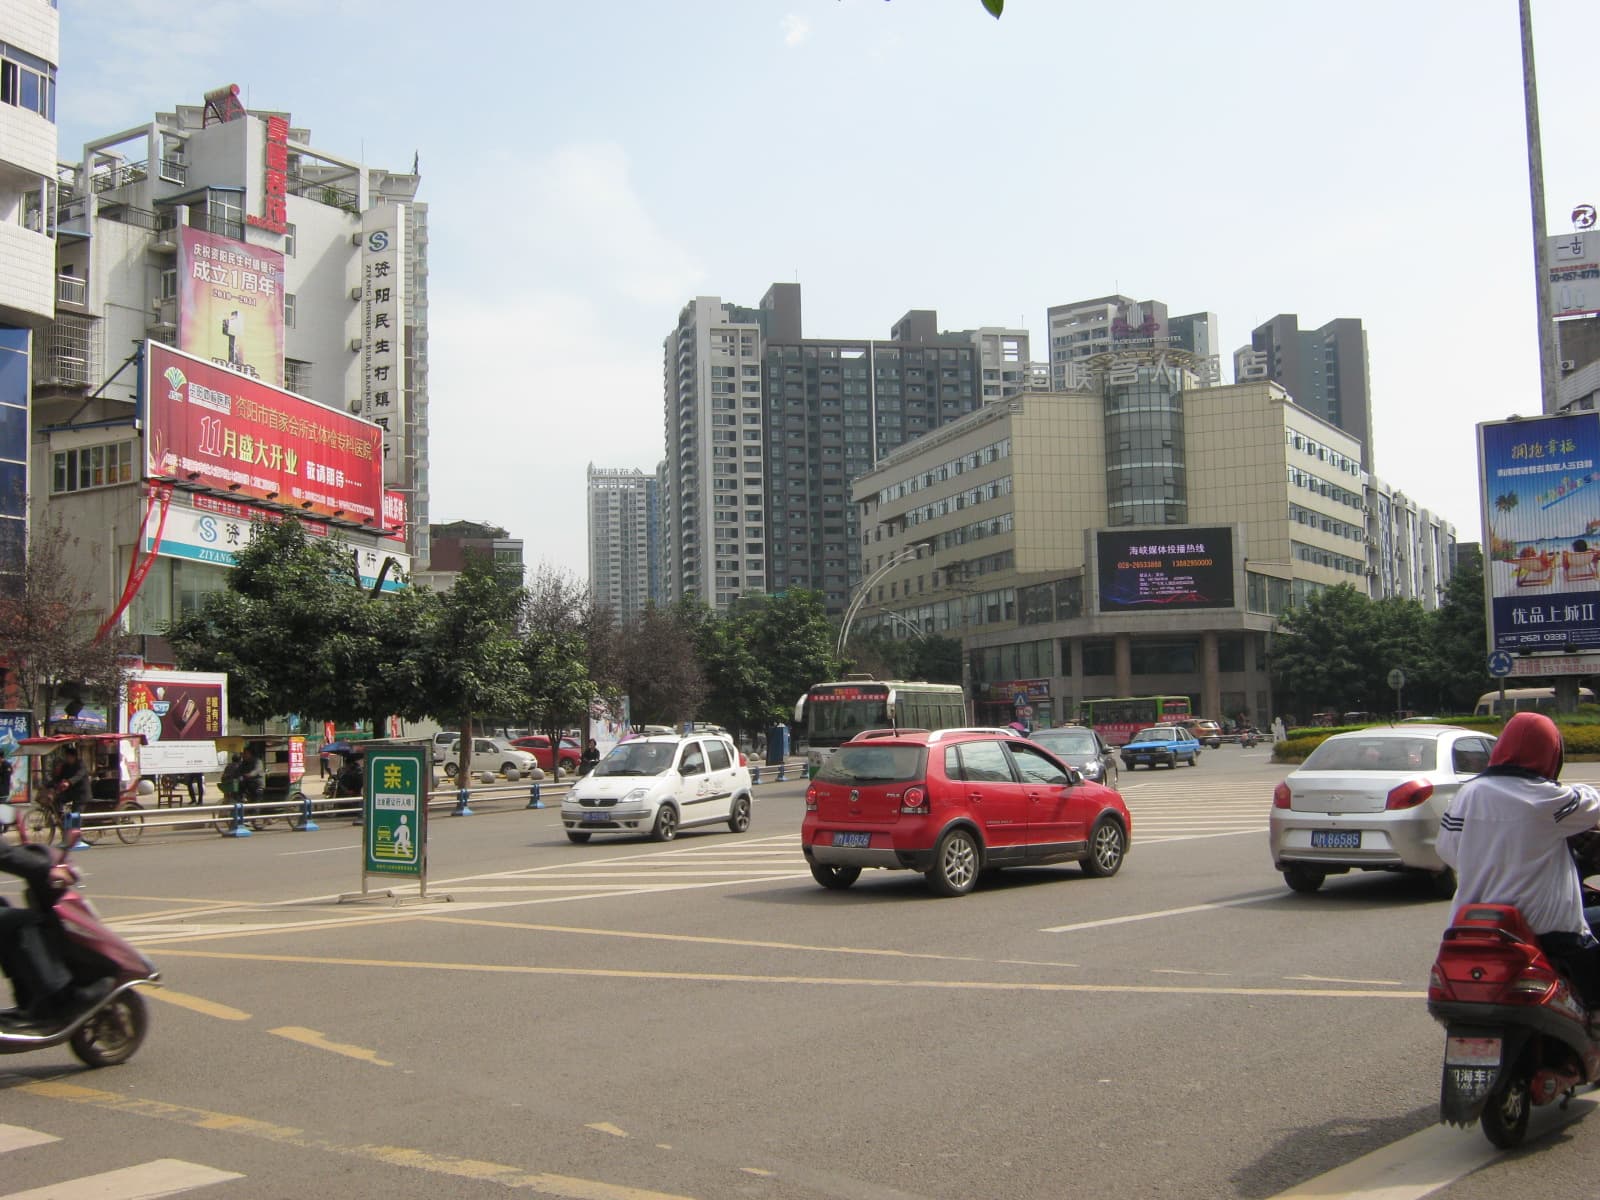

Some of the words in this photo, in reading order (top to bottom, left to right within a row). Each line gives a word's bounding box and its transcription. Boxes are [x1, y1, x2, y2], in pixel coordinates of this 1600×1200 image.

[194, 243, 277, 275] 庆祝资阳民生村镇银行
[193, 260, 276, 297] 成立1周年
